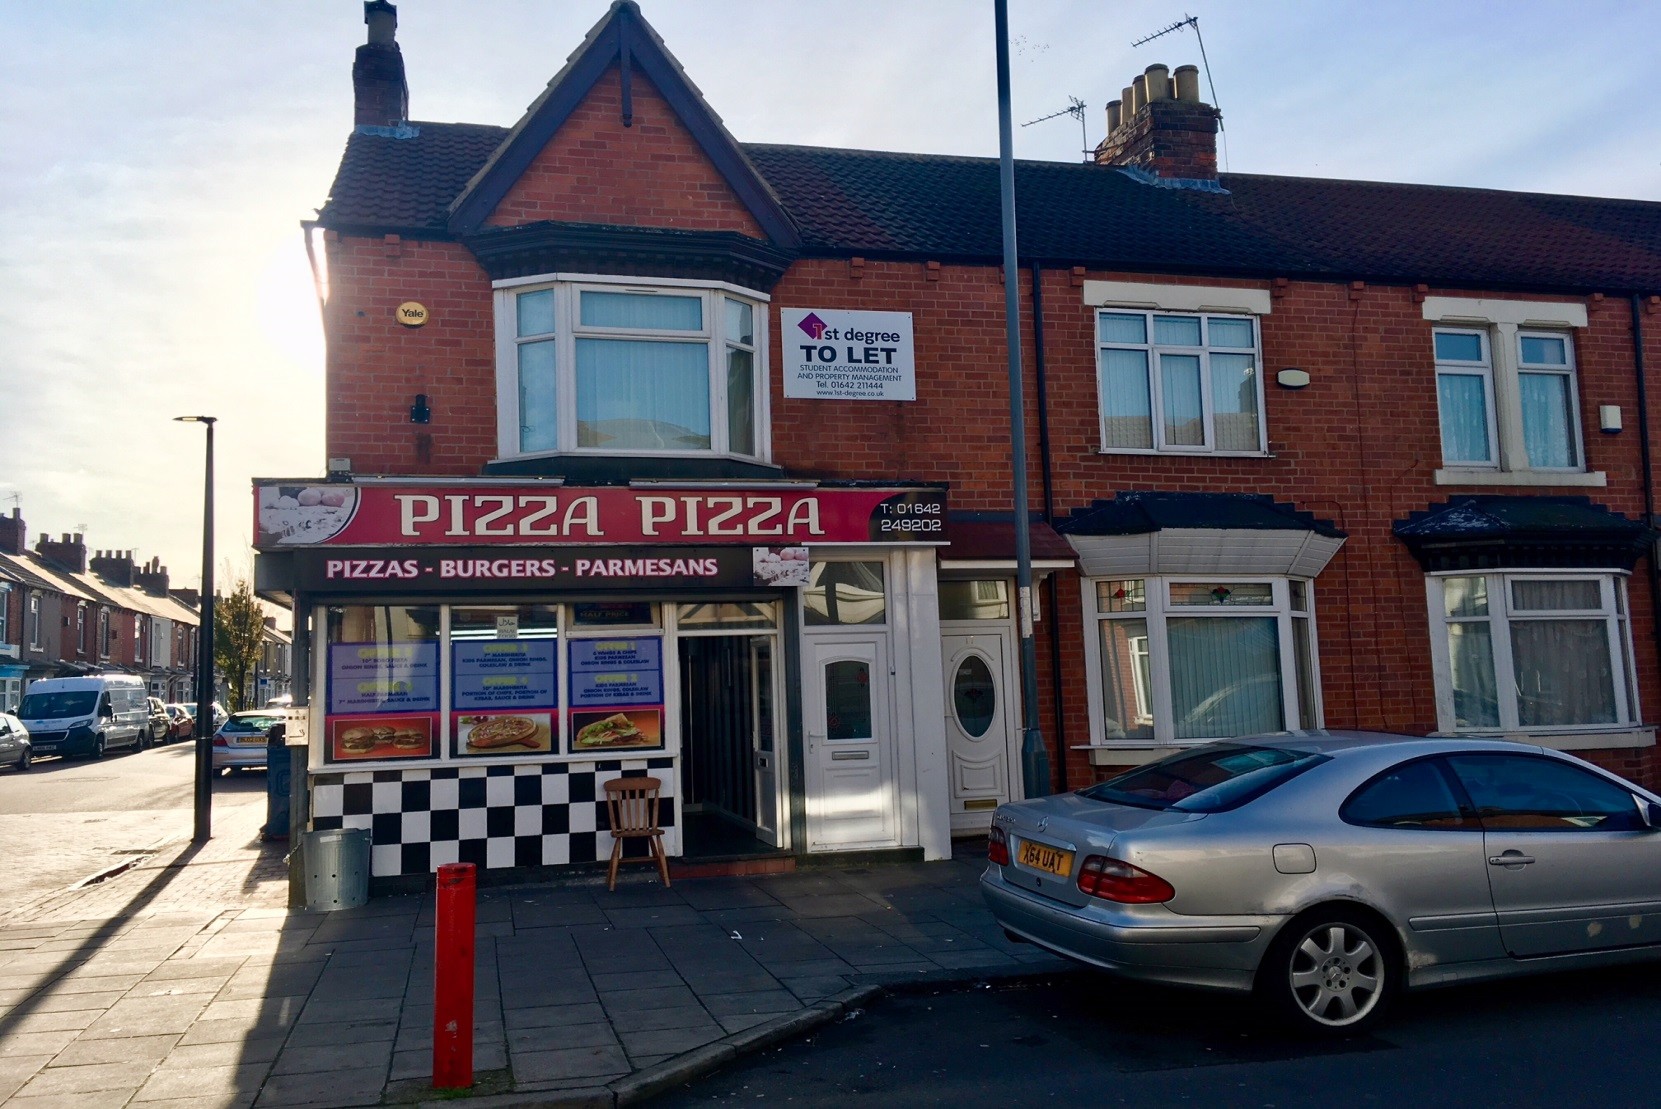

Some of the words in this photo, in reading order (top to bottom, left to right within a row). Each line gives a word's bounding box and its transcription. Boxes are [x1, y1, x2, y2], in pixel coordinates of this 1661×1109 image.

[402, 309, 423, 317] Yale
[812, 323, 839, 341] 1st
[844, 328, 901, 345] degree
[800, 345, 837, 363] TO
[847, 346, 897, 365] LET
[833, 365, 899, 373] ACCOMMODATION
[851, 374, 902, 382] MANAGEMENT
[816, 390, 884, 398] www.1st-degree.co.uk
[880, 503, 892, 514] T:
[897, 503, 941, 514] 01642
[394, 495, 604, 536] PIZZA
[635, 496, 825, 535] PIZZA
[881, 519, 942, 531] 249202
[326, 559, 418, 578] PIZZAS
[440, 559, 556, 578] BURGERS
[575, 558, 718, 577] PARMESANS
[498, 617, 516, 627] حلال
[1023, 844, 1041, 864] X64
[1042, 850, 1063, 872] UAT
